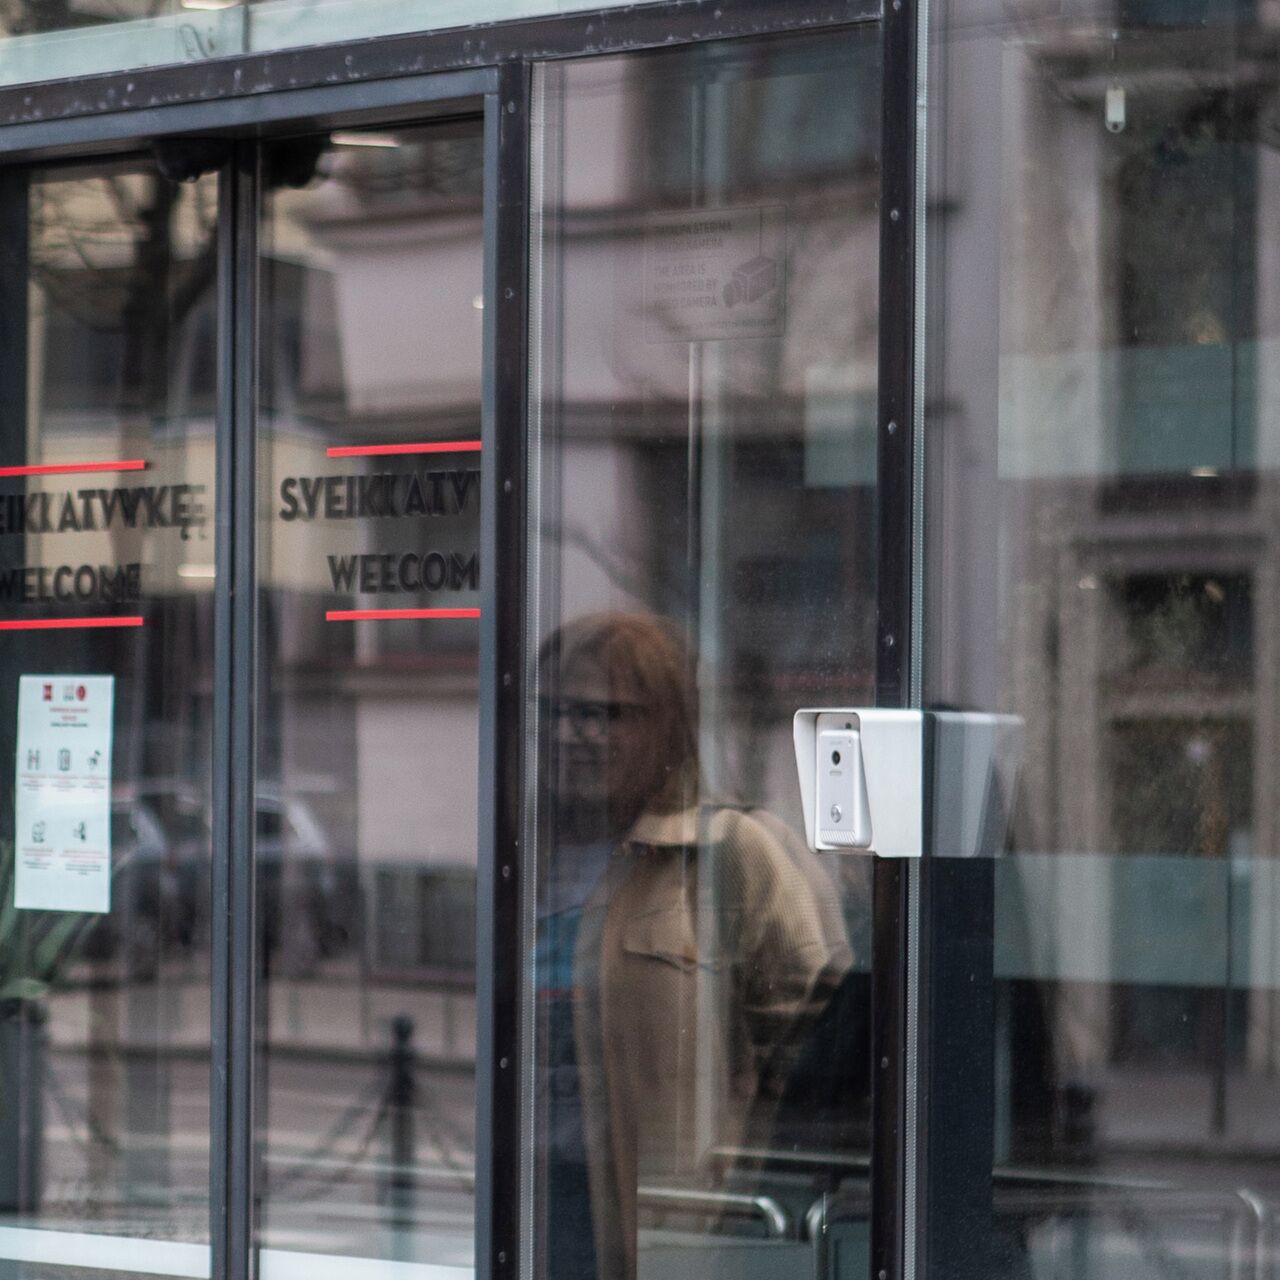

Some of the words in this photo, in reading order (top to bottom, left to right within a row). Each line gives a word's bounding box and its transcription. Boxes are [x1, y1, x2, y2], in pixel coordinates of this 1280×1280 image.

[279, 475, 400, 522] SVEIKI
[403, 469, 482, 518] ATV
[326, 551, 481, 594] WELCOM
